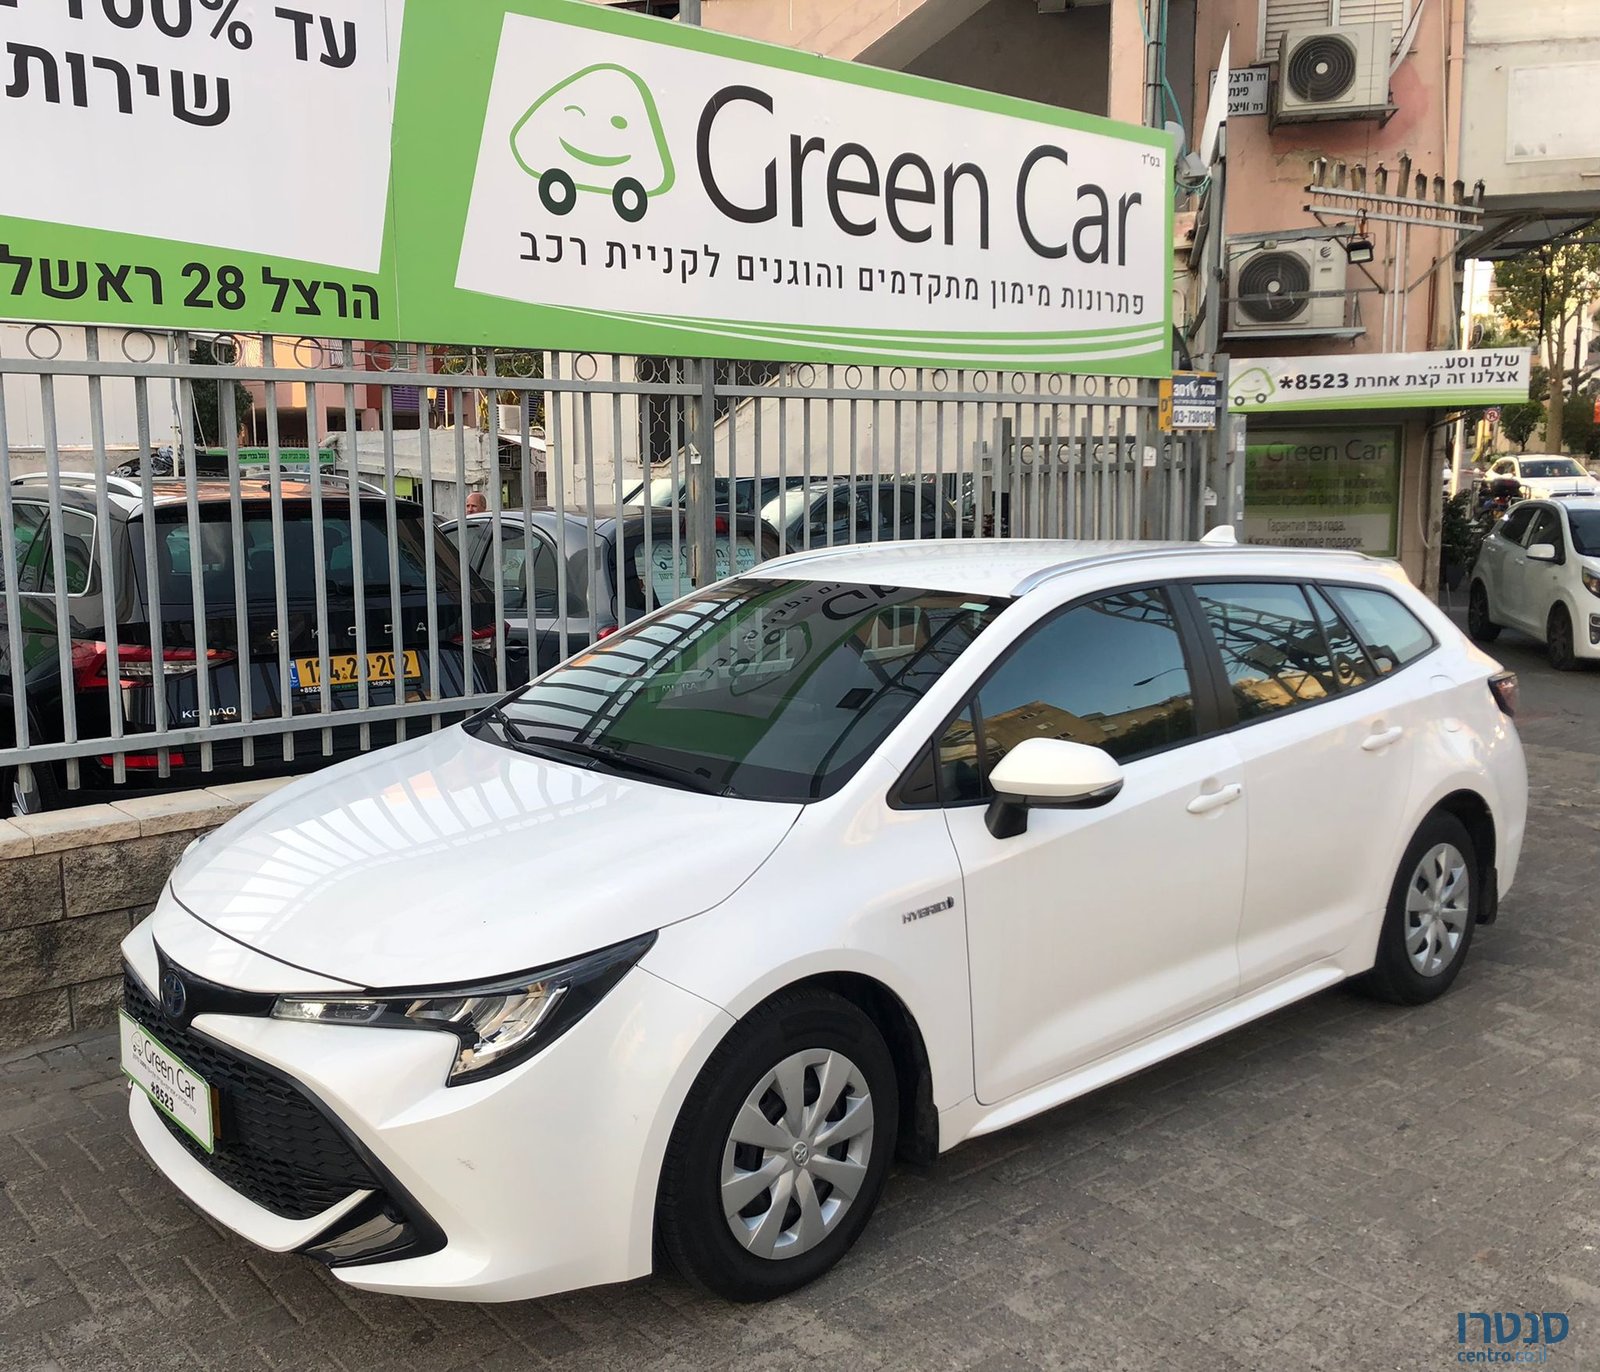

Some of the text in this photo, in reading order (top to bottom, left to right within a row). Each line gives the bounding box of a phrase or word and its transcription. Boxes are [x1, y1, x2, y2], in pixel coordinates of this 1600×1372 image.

[275, 6, 357, 69] עד
[5, 41, 231, 127] שירות
[1229, 86, 1249, 97] פינת
[1141, 152, 1161, 168] בס"ד
[696, 84, 1142, 266] Green Car
[520, 231, 1144, 315] פתרונות מימון מתקדמים והוגנים לקניית רכב
[181, 262, 246, 310] 28
[261, 266, 380, 320] הרצל
[1481, 353, 1520, 367] שלם
[1354, 375, 1400, 388] אחרת
[1405, 373, 1440, 388] קצת
[1446, 372, 1465, 384] זה
[1471, 369, 1519, 384] אצלנו
[1267, 439, 1387, 462] Green Car
[1268, 518, 1305, 534] Гарантия
[1308, 521, 1322, 533] два
[902, 901, 948, 924] HYBRID
[144, 1040, 174, 1085] Green
[176, 1068, 196, 1102] Car
